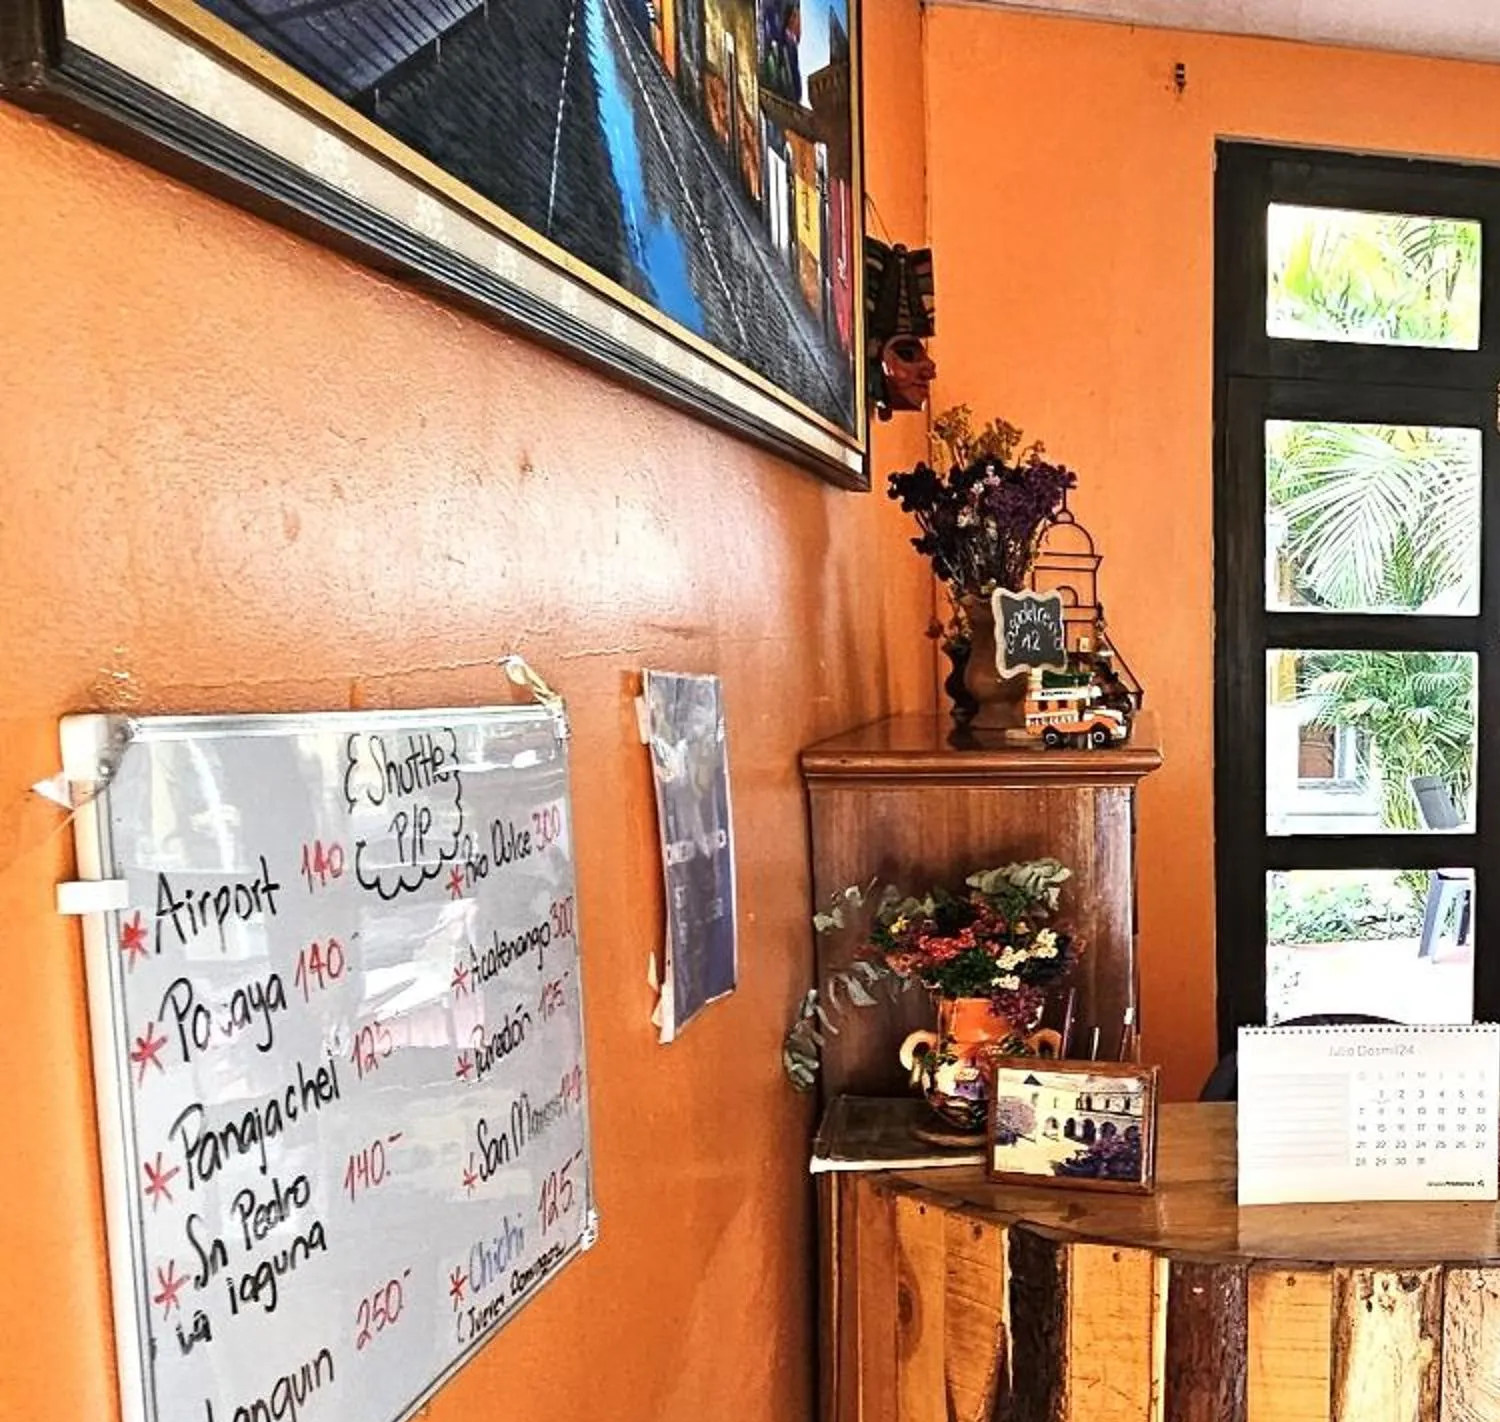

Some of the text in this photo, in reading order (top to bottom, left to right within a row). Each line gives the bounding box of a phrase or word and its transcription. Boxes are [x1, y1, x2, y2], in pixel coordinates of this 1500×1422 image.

[366, 734, 450, 806] Shuttle
[155, 840, 345, 954] Airport 140
[169, 1056, 341, 1191] Panajachel
[476, 1117, 511, 1183] San
[185, 1213, 229, 1289] Sn
[230, 1174, 311, 1252] Pedro
